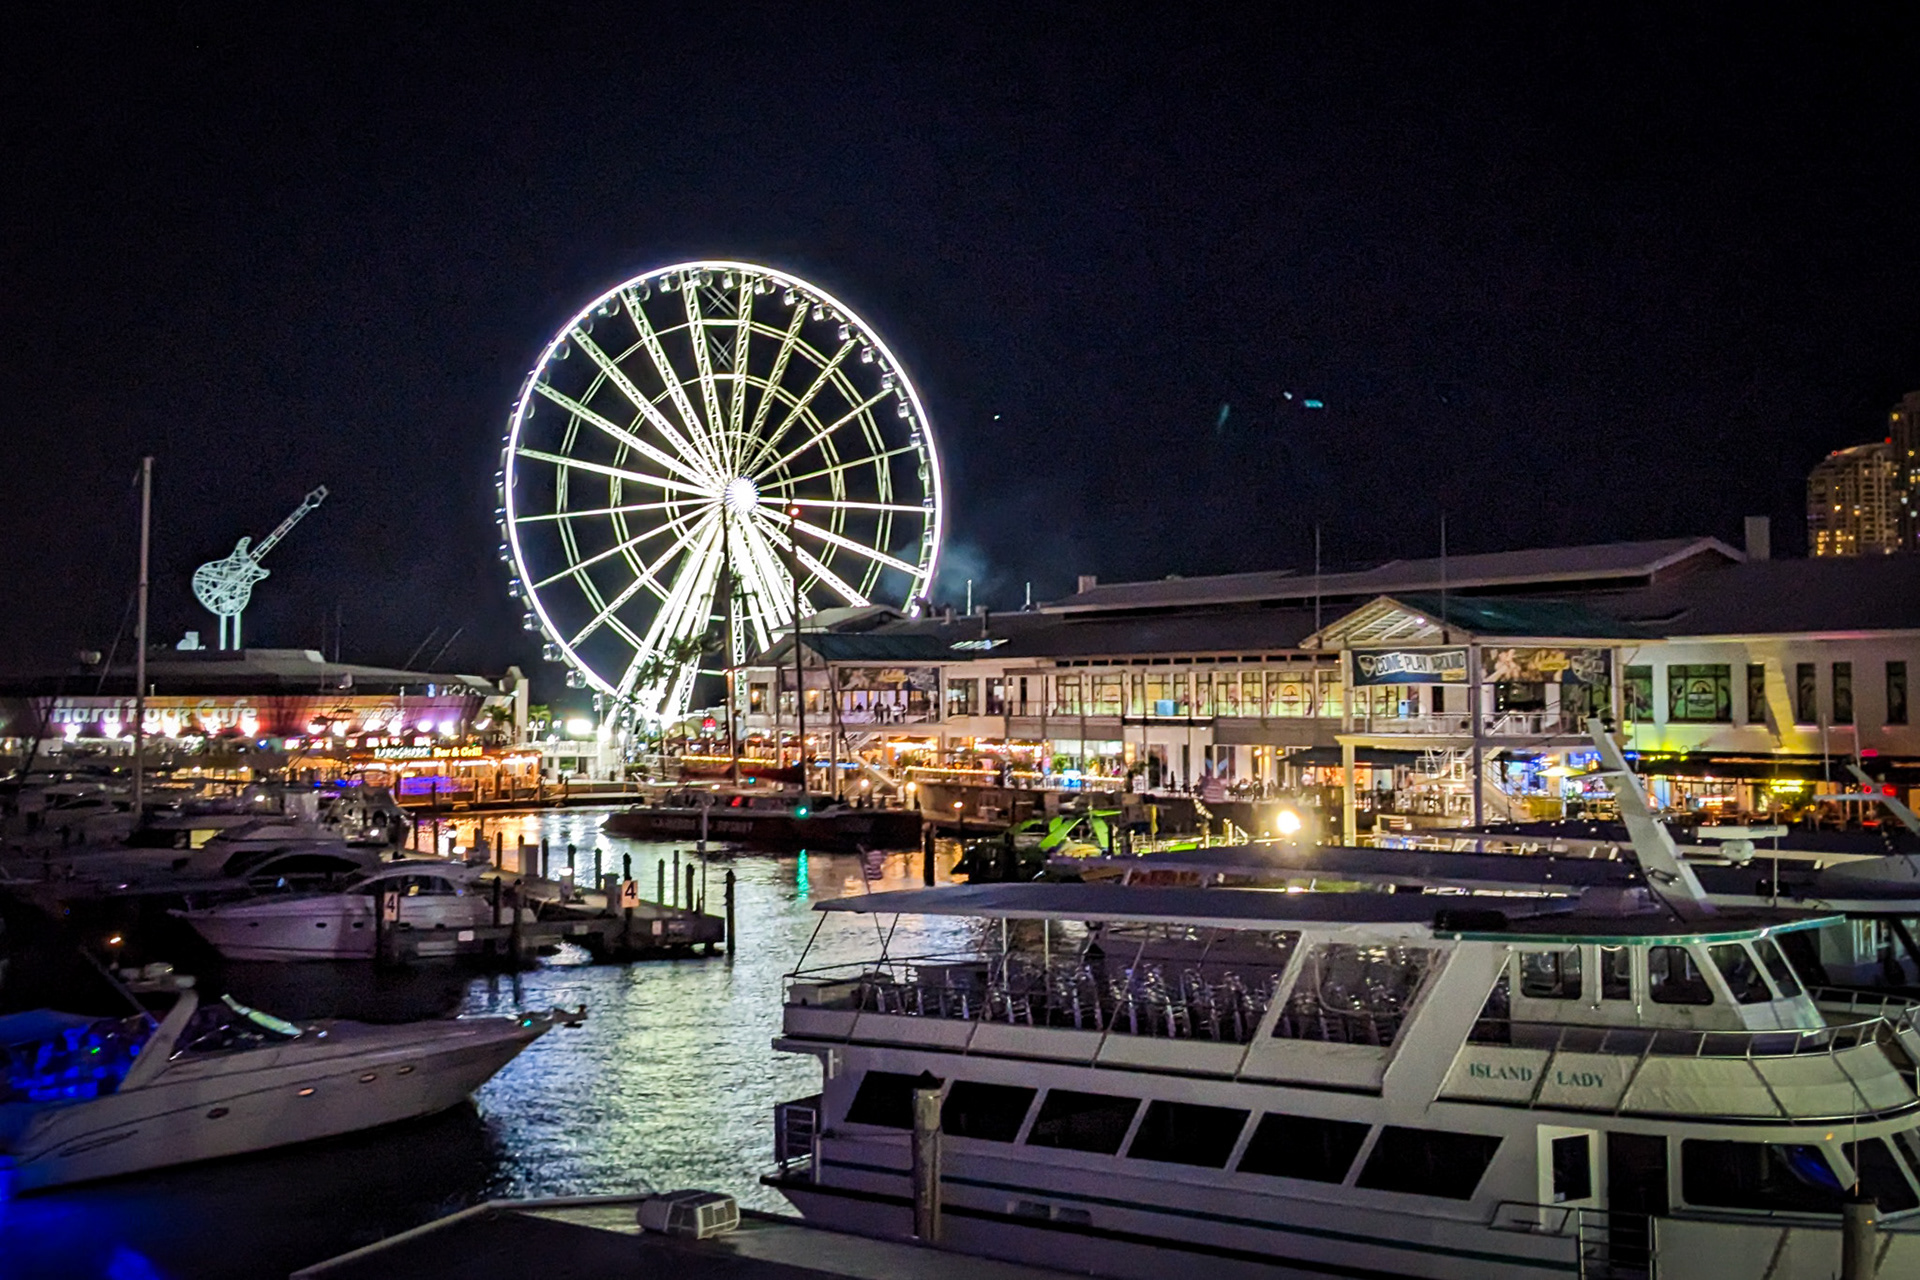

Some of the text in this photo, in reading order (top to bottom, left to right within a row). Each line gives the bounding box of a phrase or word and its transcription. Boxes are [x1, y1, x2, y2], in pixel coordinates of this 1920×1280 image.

[1403, 655, 1428, 671] PLAY
[53, 699, 122, 724] Hard
[195, 699, 258, 728] Cafe
[433, 747, 451, 757] Bar
[451, 747, 459, 757] &
[460, 746, 483, 757] Grill
[625, 881, 636, 900] 4
[387, 894, 395, 913] 4
[1469, 1063, 1605, 1088] ISLAND LADY
